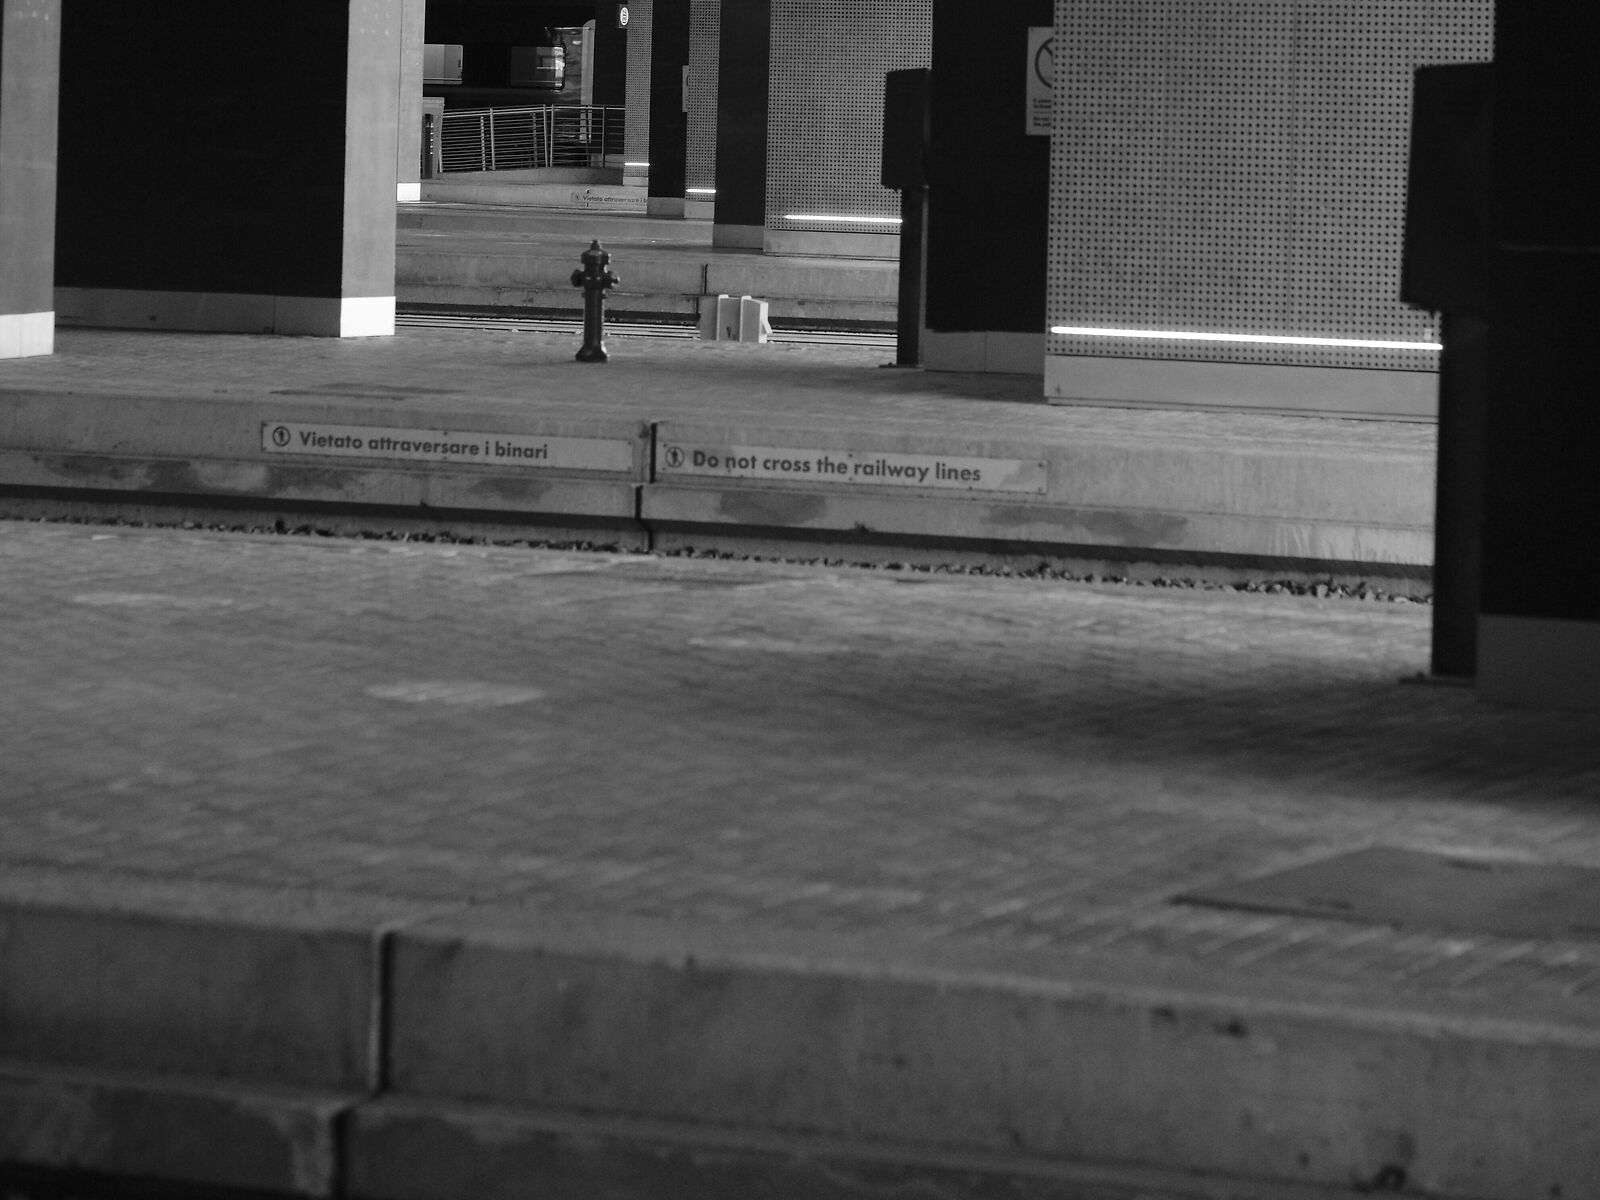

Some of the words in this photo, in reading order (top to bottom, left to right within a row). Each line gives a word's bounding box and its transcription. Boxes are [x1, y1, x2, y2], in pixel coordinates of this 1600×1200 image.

[299, 431, 363, 449] Vietato
[368, 436, 479, 456] attraversare
[485, 441, 489, 455] i
[495, 441, 547, 459] binari
[693, 451, 718, 468] Do
[726, 454, 757, 468] not
[763, 458, 810, 472] cross
[817, 456, 848, 474] the
[854, 460, 930, 482] railway
[936, 462, 981, 481] lines
